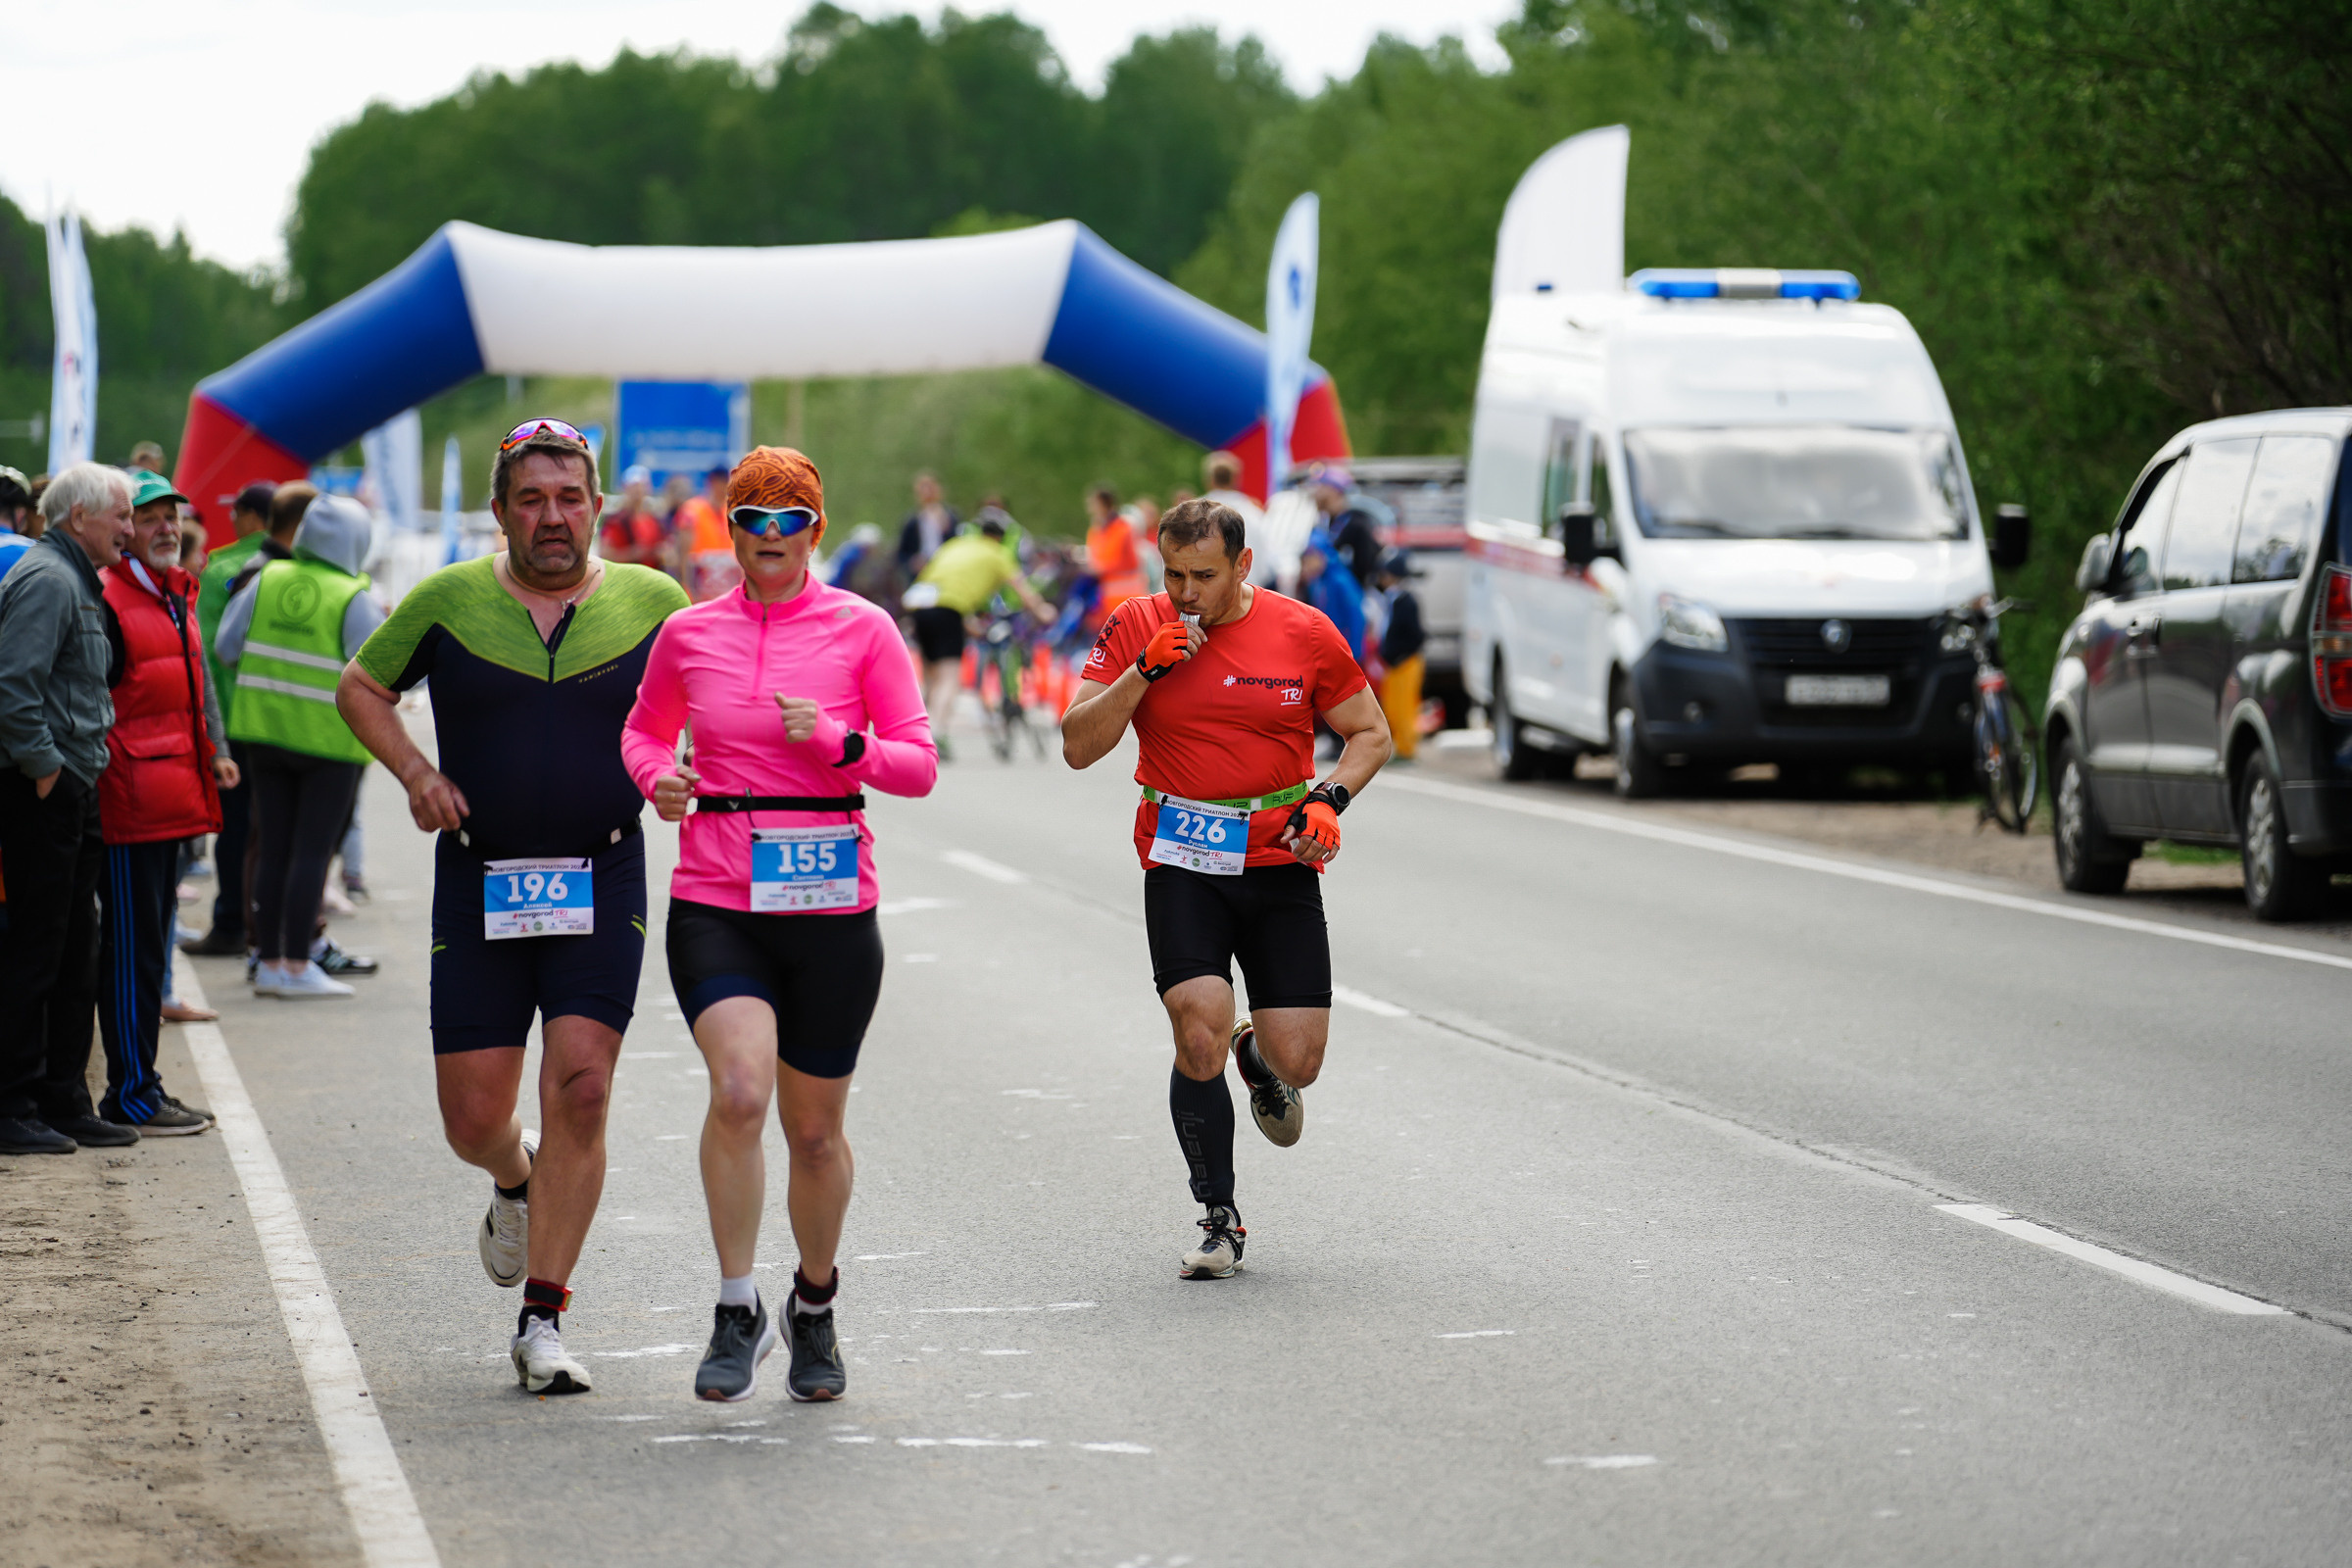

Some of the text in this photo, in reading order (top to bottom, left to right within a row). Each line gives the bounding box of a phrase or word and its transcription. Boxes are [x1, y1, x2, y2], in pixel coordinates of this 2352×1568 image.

[1223, 674, 1303, 689] #novgorod
[1280, 688, 1303, 702] TRI
[1202, 807, 1230, 816] ТРИАТЛОН
[1174, 810, 1227, 844] 226
[778, 842, 837, 873] 155
[508, 872, 568, 903] 196
